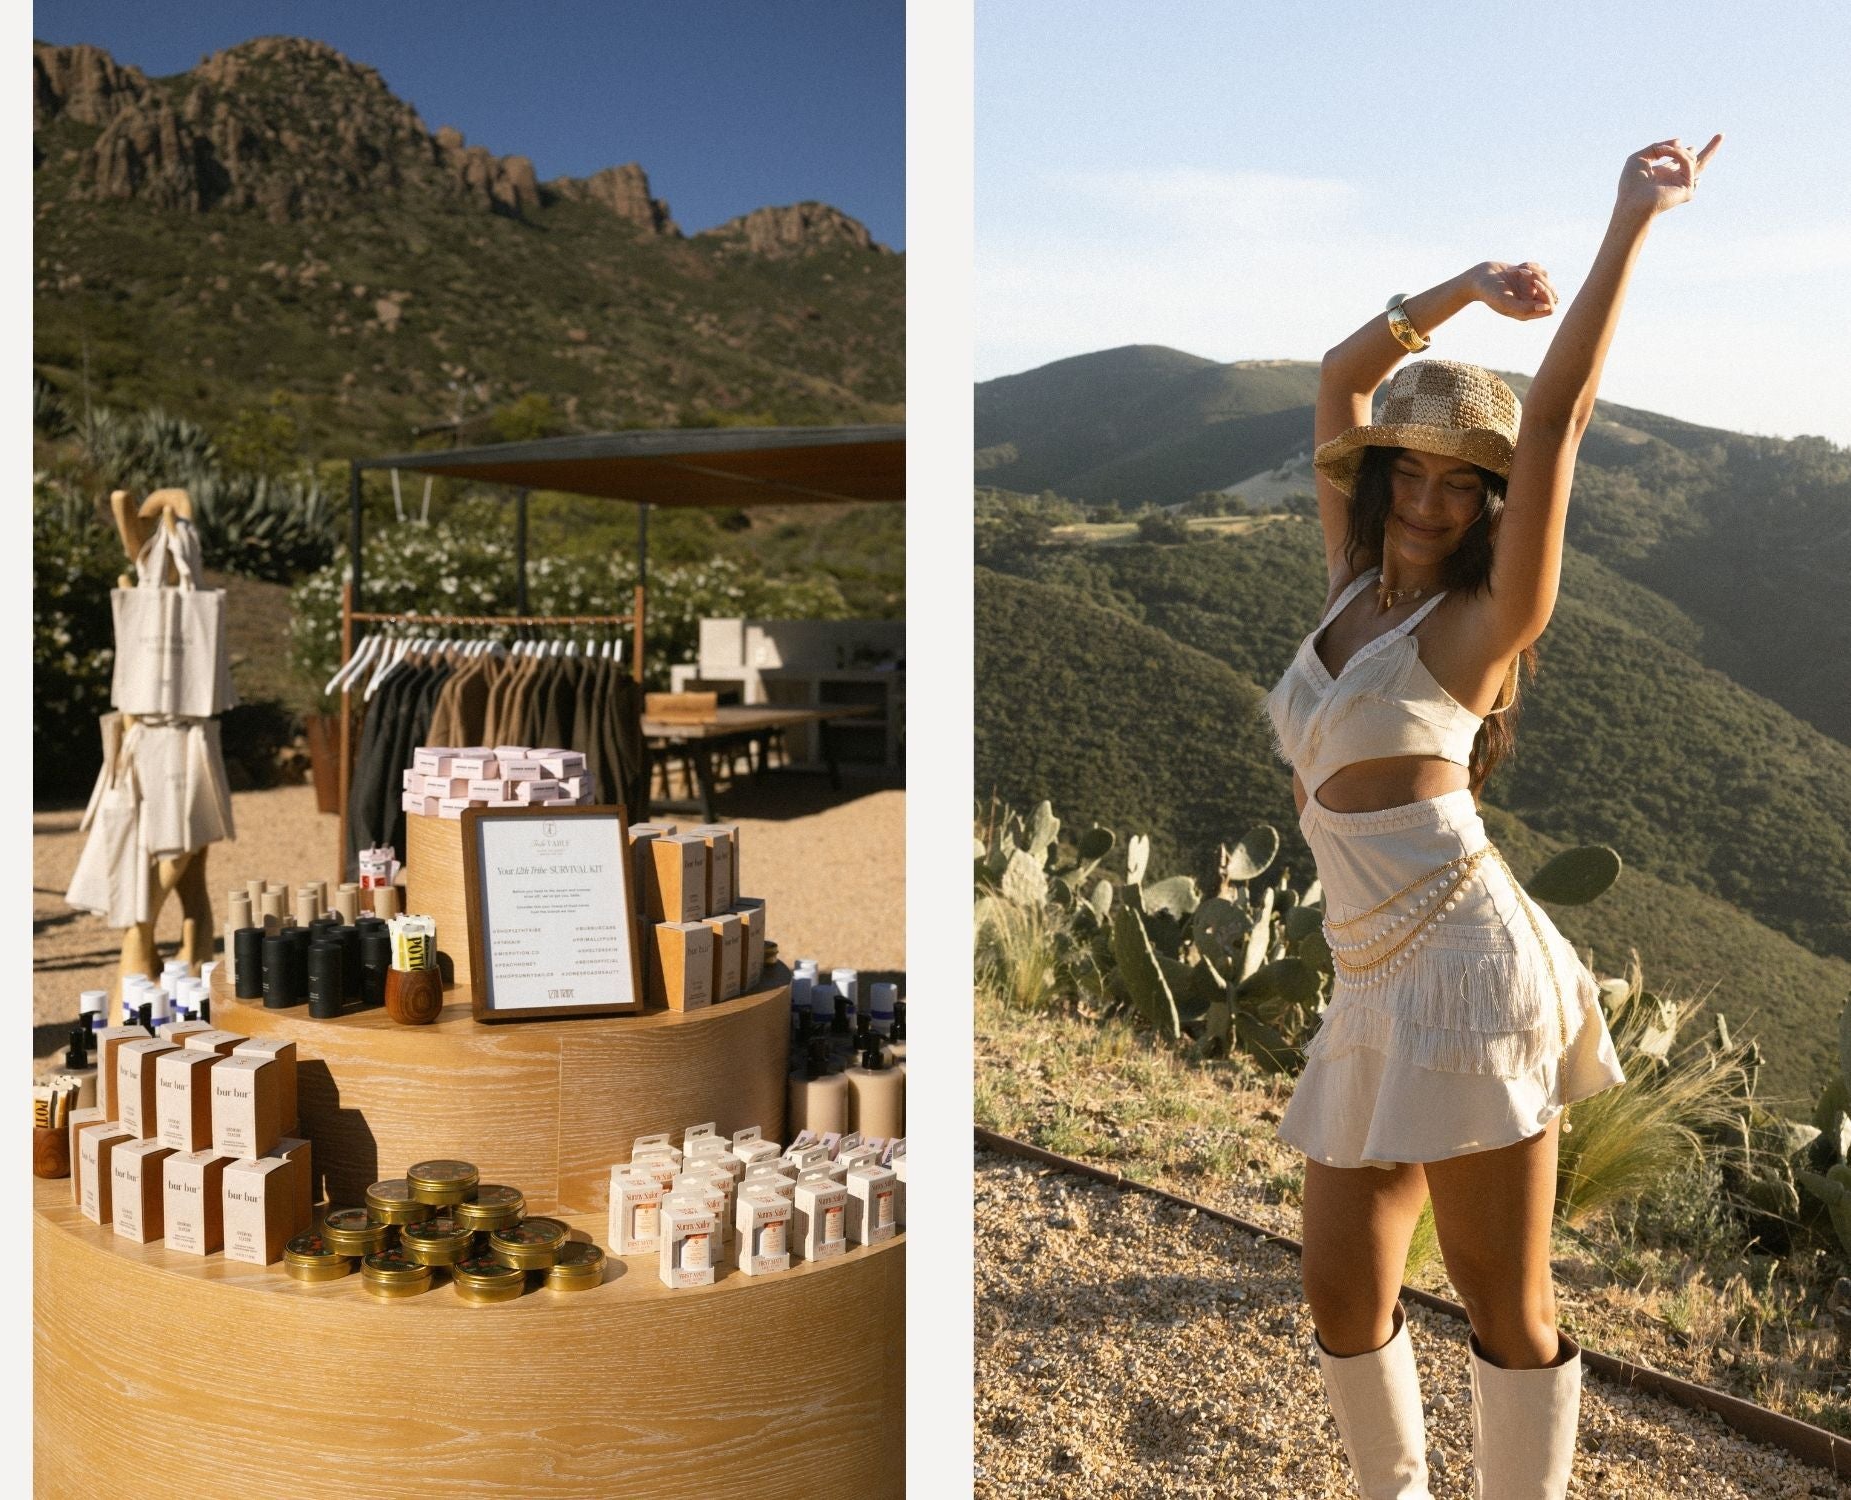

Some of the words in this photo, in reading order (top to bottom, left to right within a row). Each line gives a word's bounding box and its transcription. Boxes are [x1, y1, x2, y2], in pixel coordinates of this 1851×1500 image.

[497, 866, 514, 876] Your
[515, 865, 530, 876] 12th
[530, 865, 548, 874] Tribe
[549, 864, 588, 874] SURVIVAL
[589, 864, 604, 873] KIT
[406, 937, 424, 971] POTI
[216, 1086, 231, 1098] bur
[168, 1180, 182, 1192] bur
[228, 1189, 242, 1201] bur
